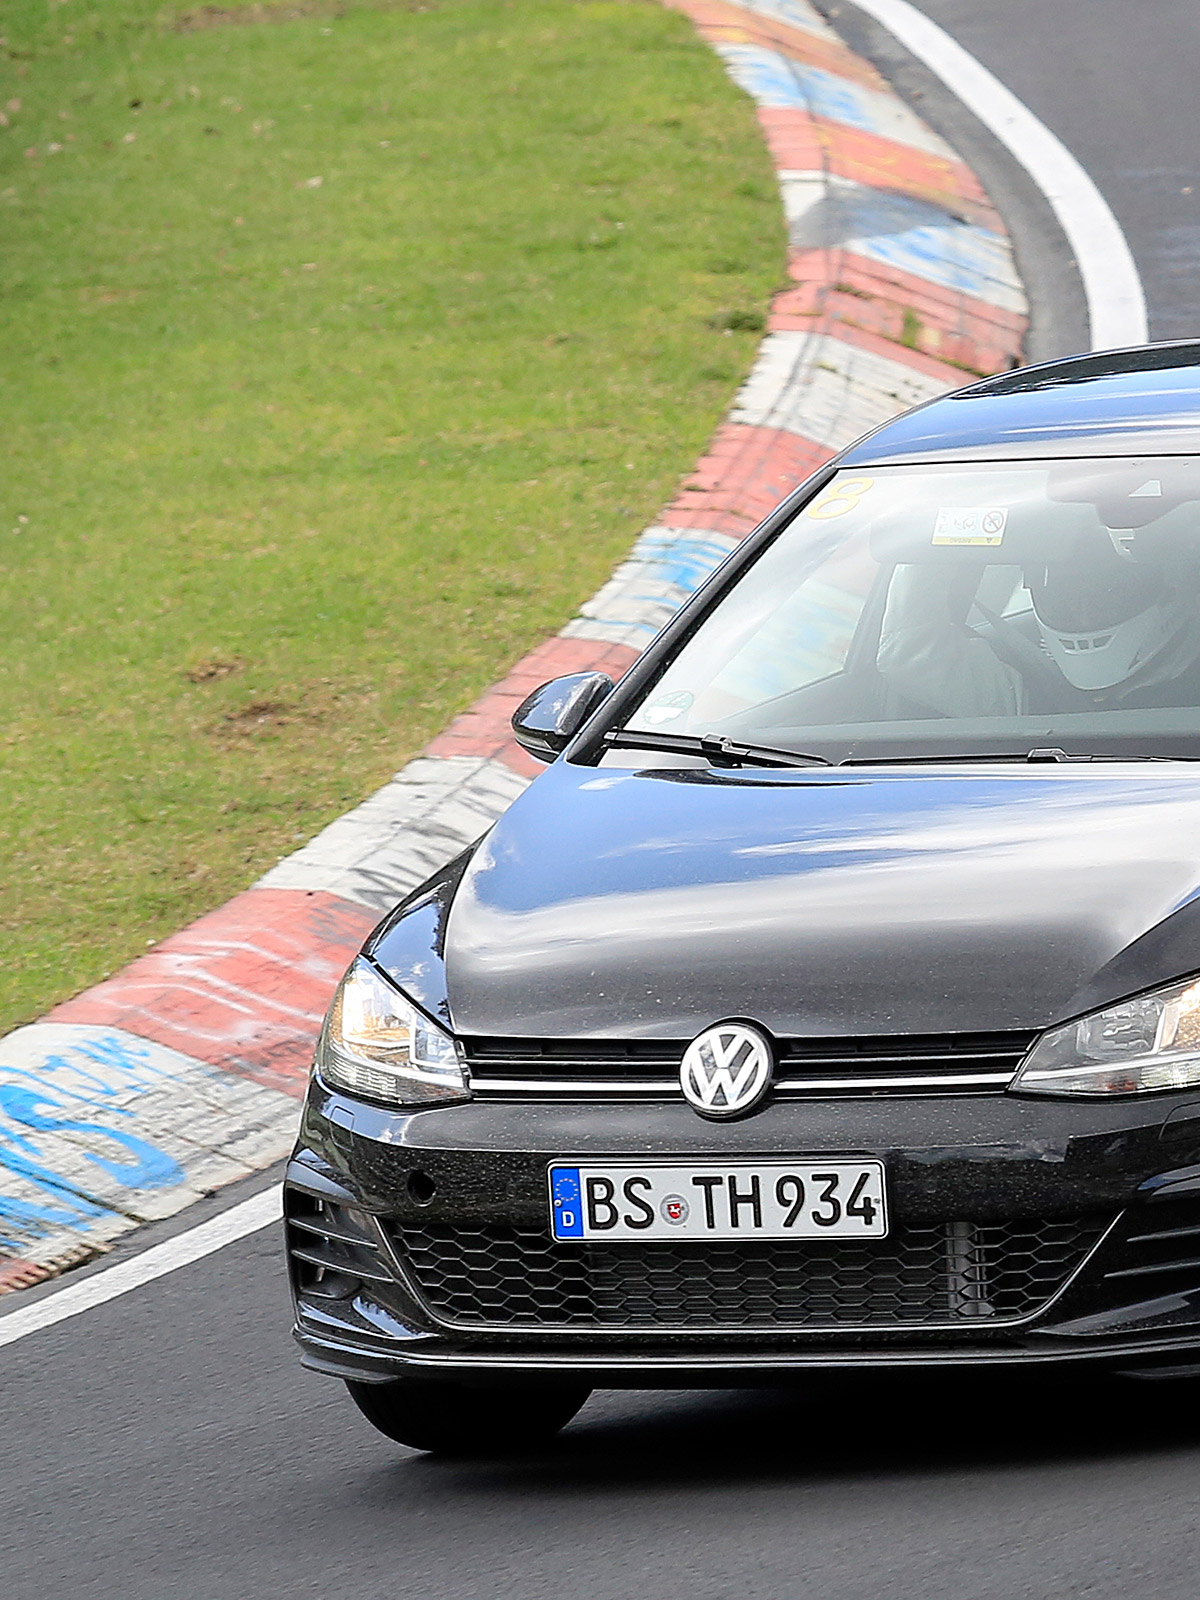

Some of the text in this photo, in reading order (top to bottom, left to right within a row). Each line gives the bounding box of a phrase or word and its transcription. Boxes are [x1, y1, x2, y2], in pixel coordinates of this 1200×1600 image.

[562, 1210, 576, 1227] D
[585, 1172, 877, 1231] BS TH 934
